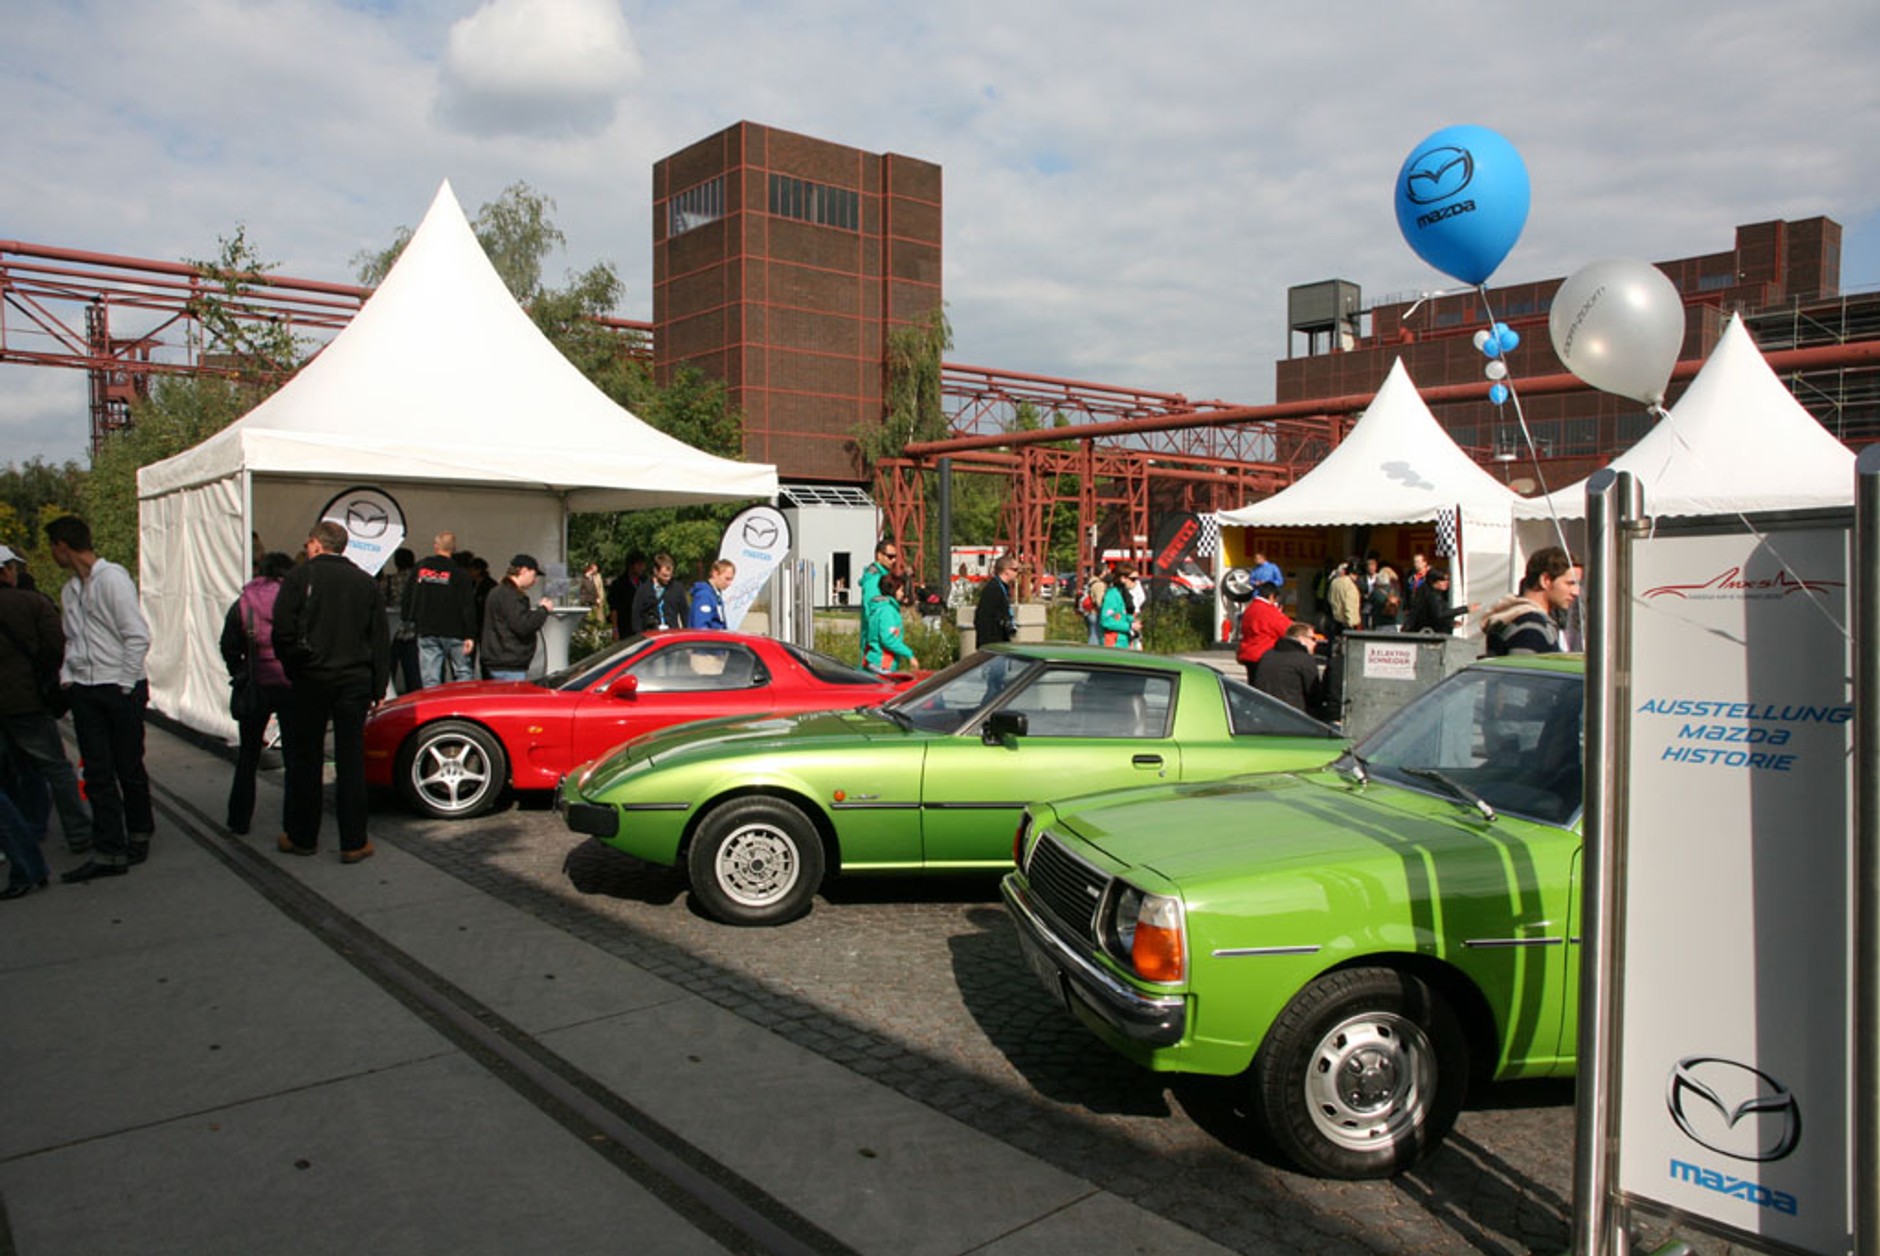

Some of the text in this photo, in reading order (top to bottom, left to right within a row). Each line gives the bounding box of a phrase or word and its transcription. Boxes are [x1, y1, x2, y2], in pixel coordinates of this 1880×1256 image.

[1416, 198, 1476, 229] mazda
[1637, 699, 1853, 724] AUSSTELLUNG
[1678, 723, 1792, 745] Mazda
[1661, 746, 1798, 771] HISTORIE
[1669, 1158, 1798, 1217] mazda
